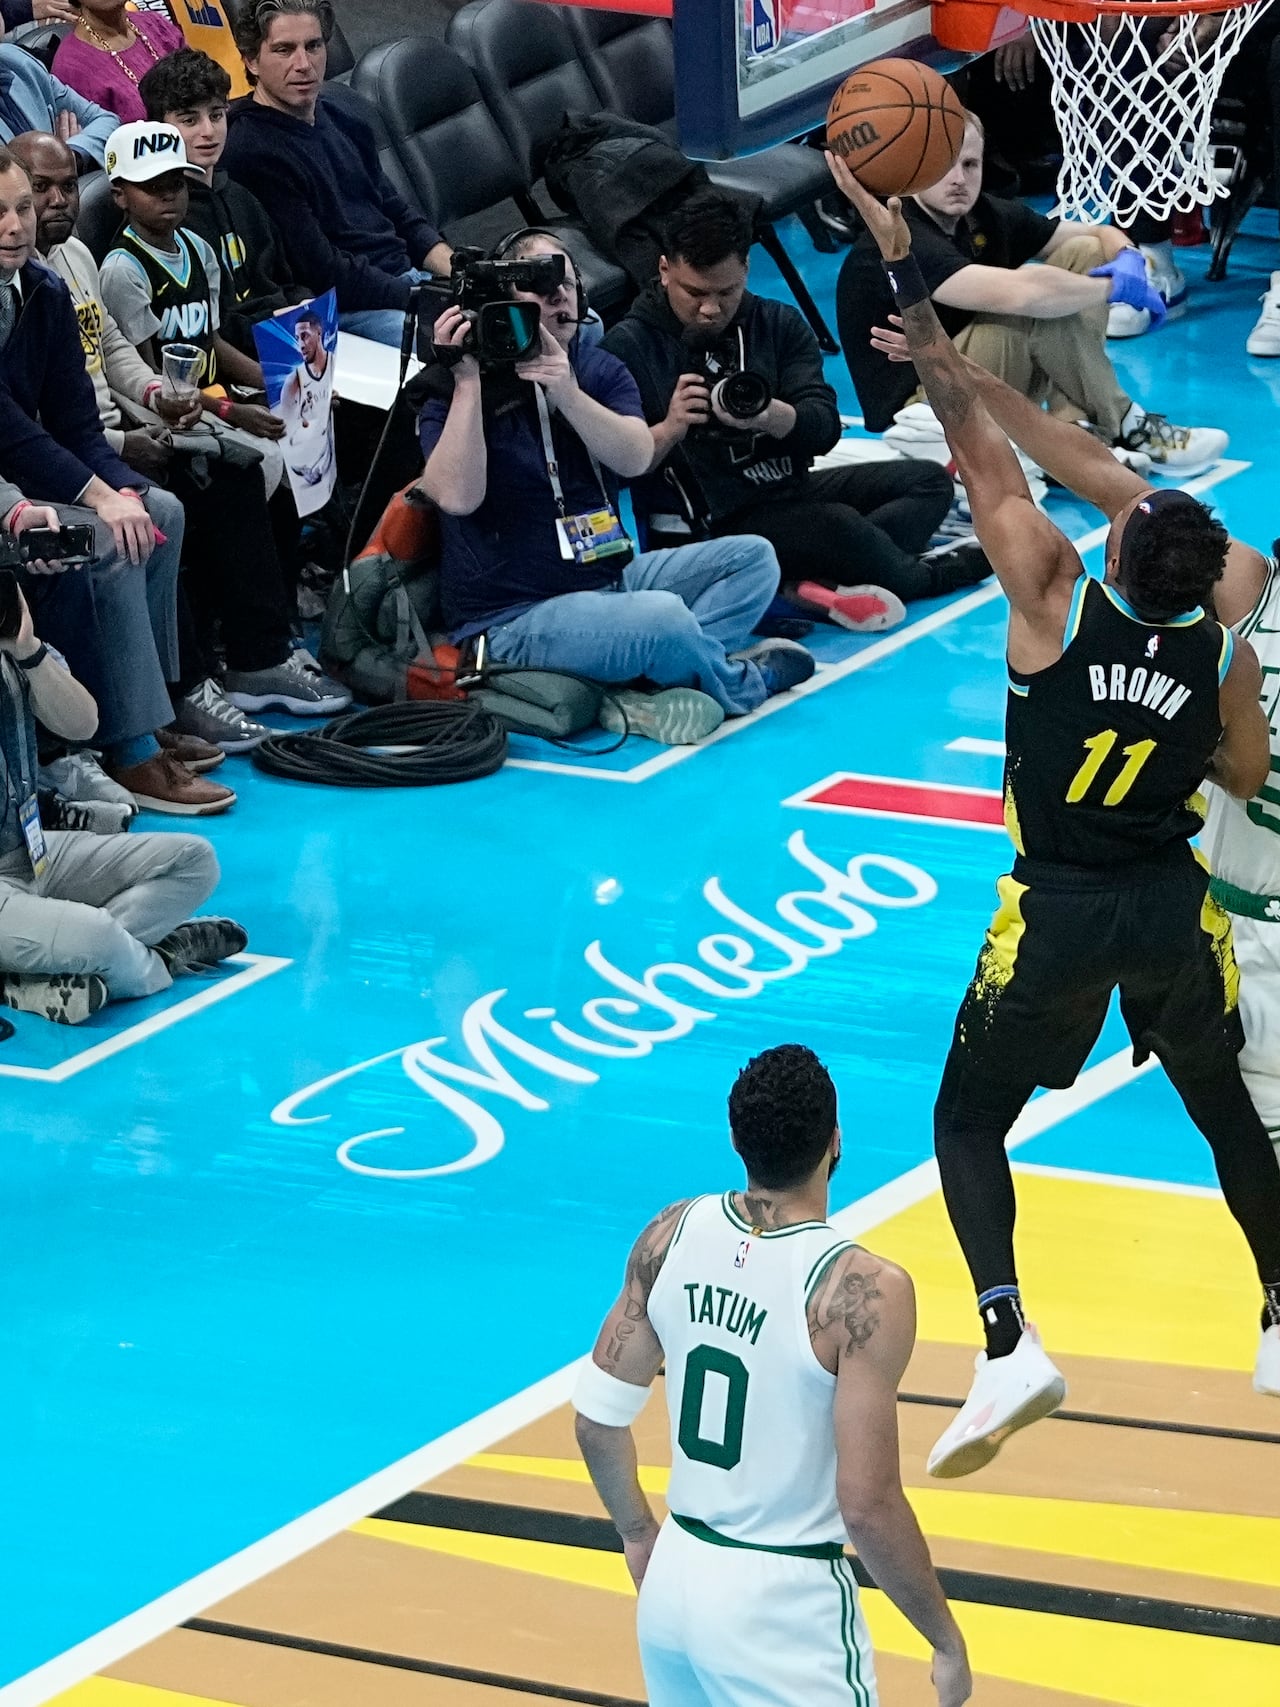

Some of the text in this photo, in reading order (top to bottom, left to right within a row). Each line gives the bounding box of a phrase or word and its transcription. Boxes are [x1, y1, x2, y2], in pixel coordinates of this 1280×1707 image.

[755, 21, 771, 48] NBA
[133, 132, 180, 160] INDY
[1088, 663, 1193, 721] BROWN
[1065, 728, 1157, 806] 11
[270, 829, 938, 1178] Michelob
[683, 1282, 768, 1346] TATUM
[678, 1343, 749, 1471] 0
